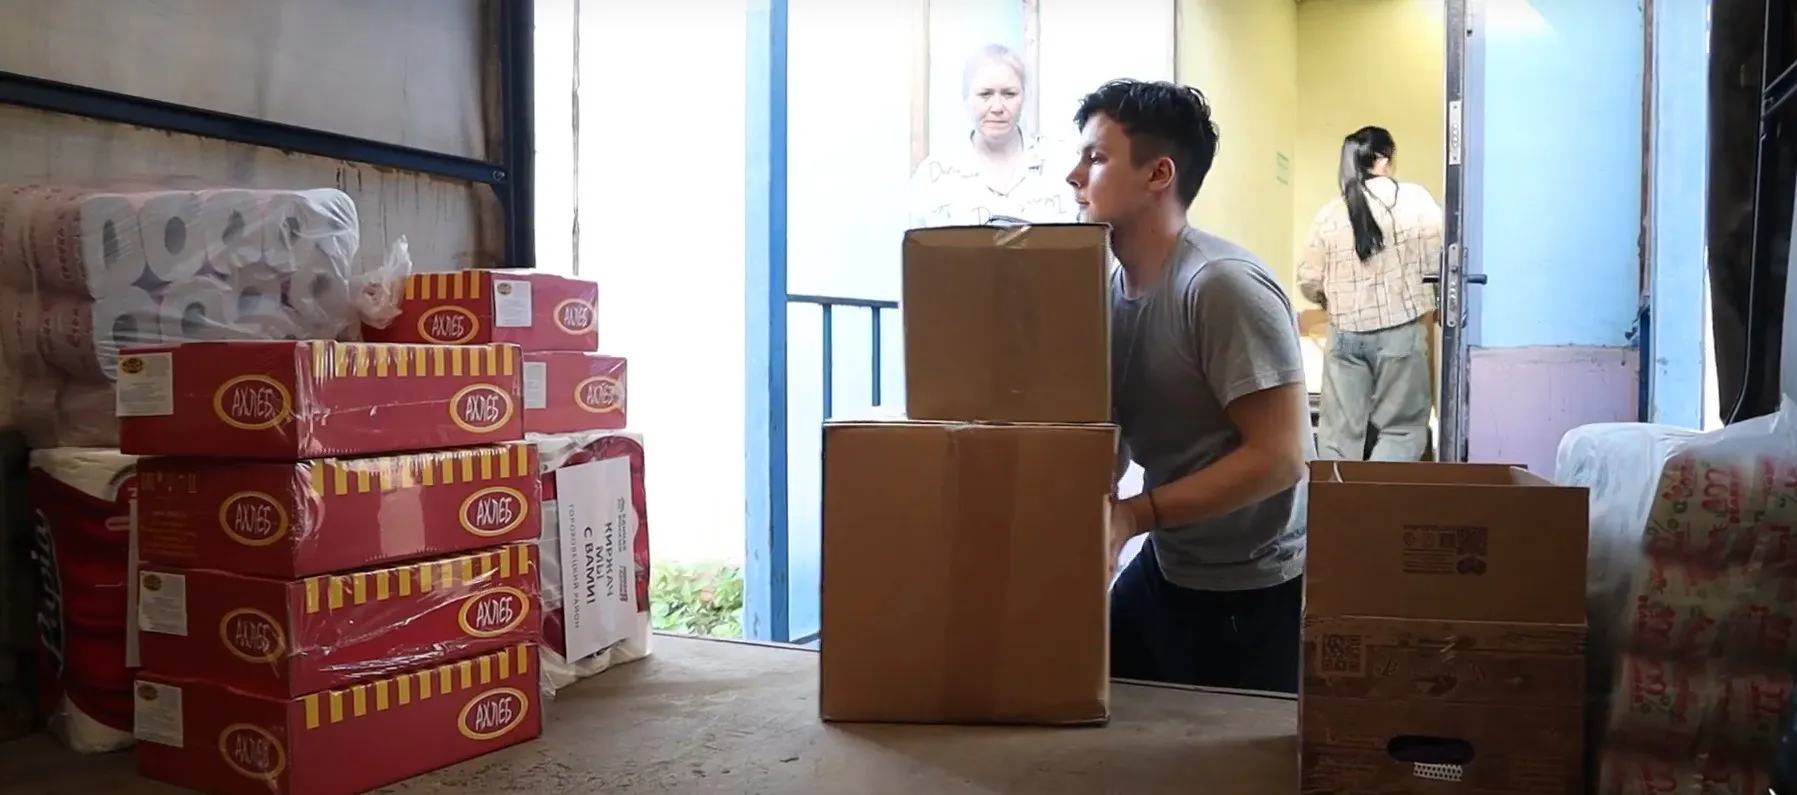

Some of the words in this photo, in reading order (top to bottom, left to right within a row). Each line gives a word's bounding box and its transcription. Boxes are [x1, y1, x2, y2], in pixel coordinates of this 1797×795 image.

[430, 314, 465, 338] АХЛЕБ
[231, 385, 276, 418] АХЛЕБ
[464, 395, 500, 423] АХЛЕБ
[235, 502, 272, 535] АХЛЕБ
[475, 496, 513, 527] АХЛЕБ
[584, 526, 592, 538] С
[585, 543, 595, 604] ВАМИ!
[595, 546, 604, 580] МЫ
[604, 521, 613, 597] КИРЖАЧ
[475, 598, 514, 628] АХЛЕБ
[475, 698, 513, 730] АХЛЕБ
